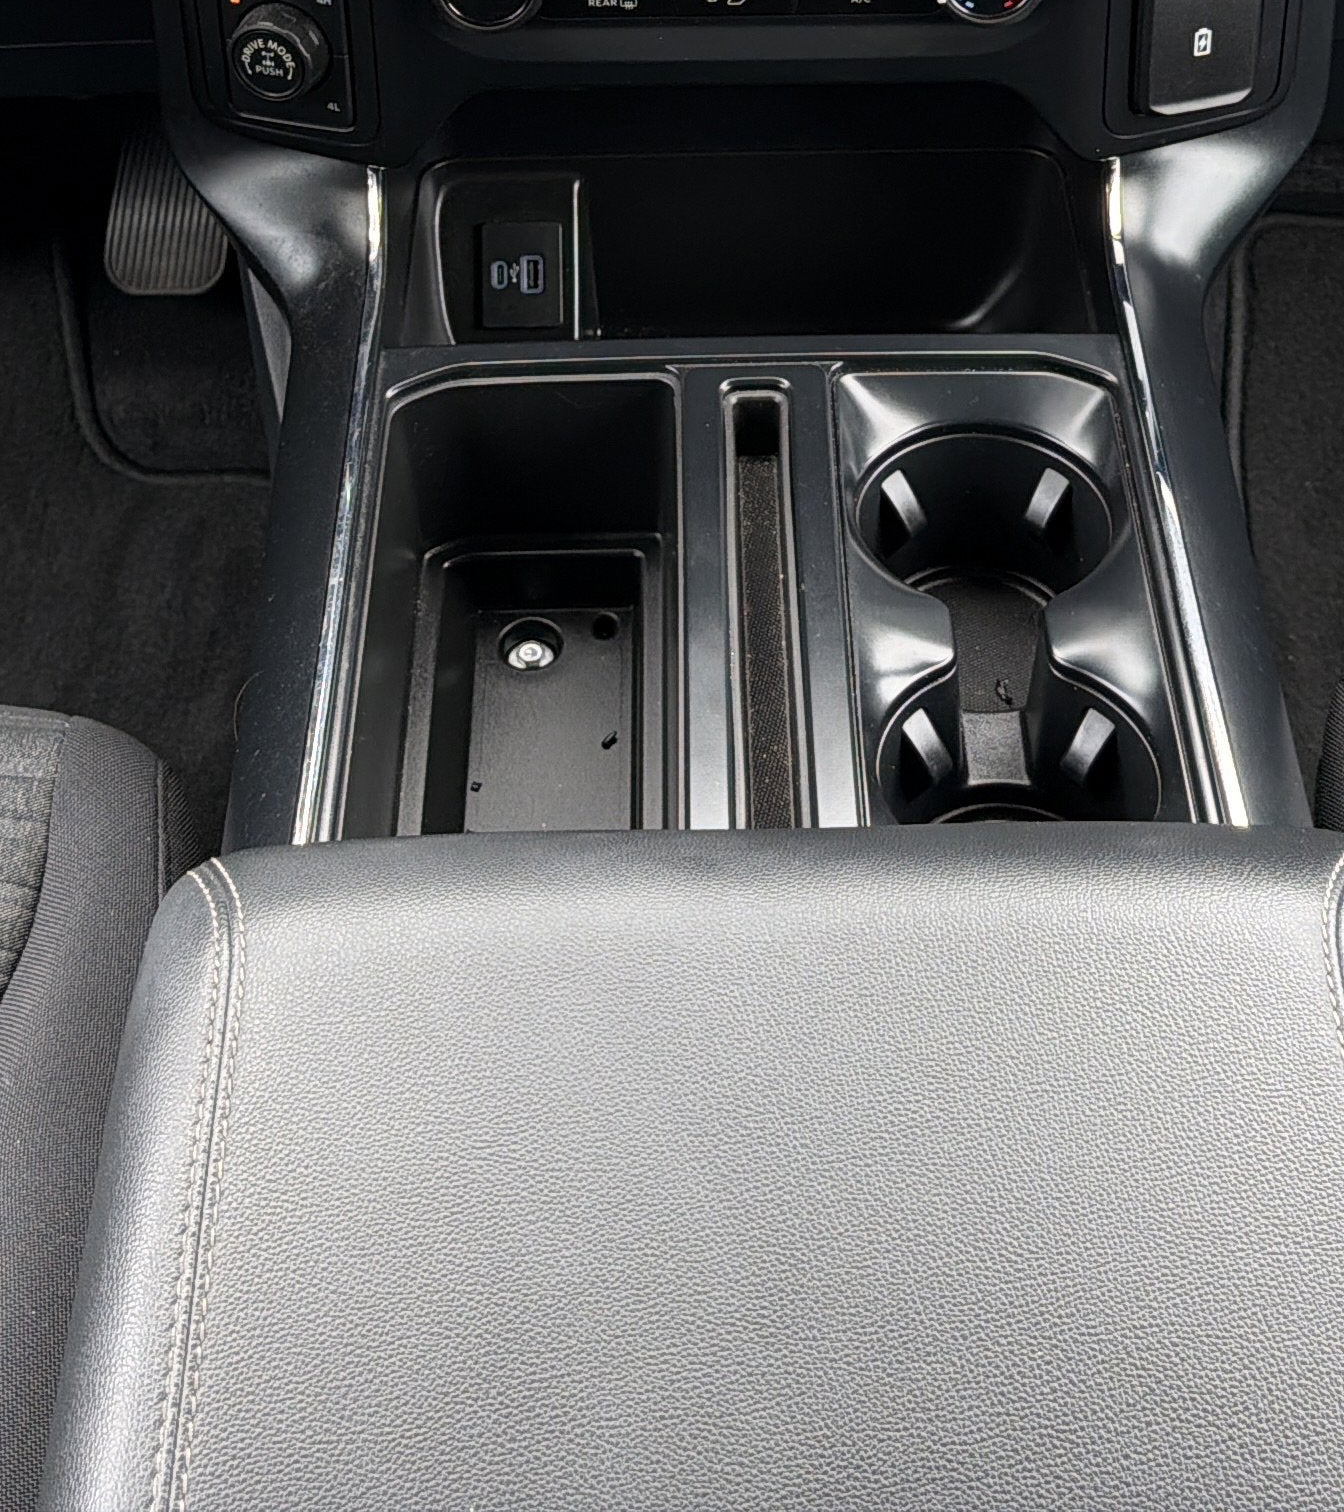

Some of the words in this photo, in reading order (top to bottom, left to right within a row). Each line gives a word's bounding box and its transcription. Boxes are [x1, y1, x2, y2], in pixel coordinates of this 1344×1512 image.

[241, 38, 264, 63] DRIVE
[267, 39, 296, 69] MODE
[256, 64, 284, 77] PUSH
[327, 101, 341, 112] 4L
